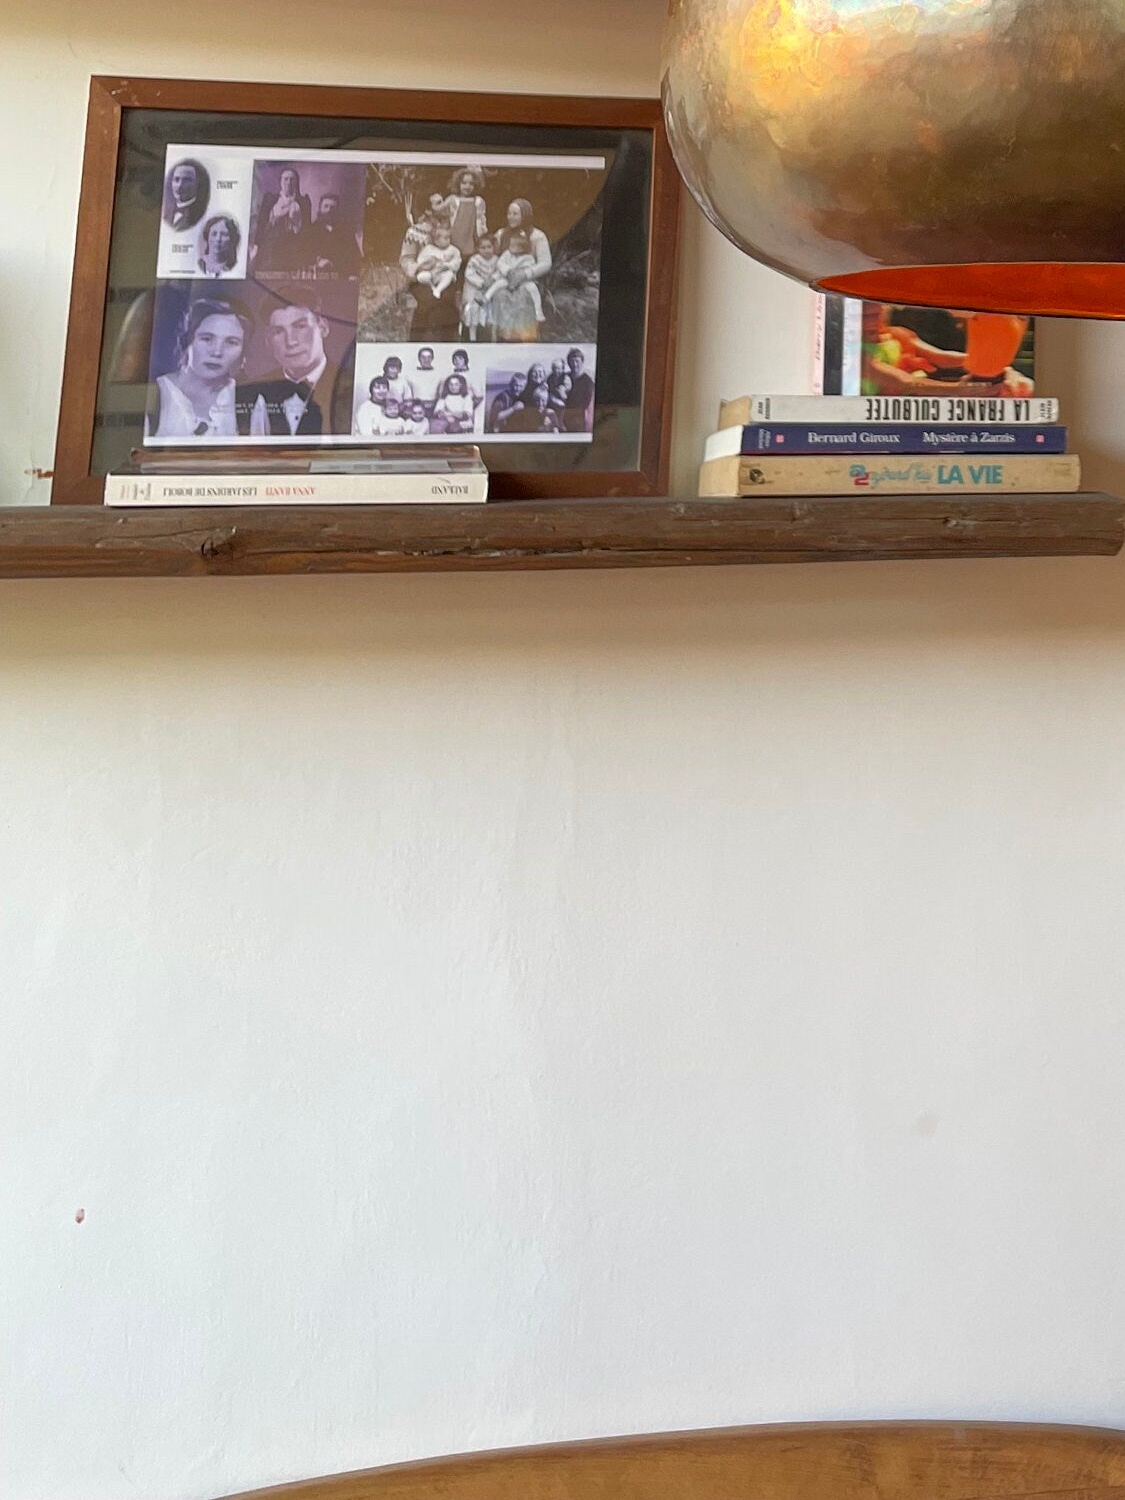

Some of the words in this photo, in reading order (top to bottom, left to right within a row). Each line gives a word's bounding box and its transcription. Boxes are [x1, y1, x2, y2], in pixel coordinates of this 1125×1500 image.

[947, 399, 1005, 421] FRANCE
[1013, 399, 1030, 421] LA
[807, 431, 857, 444] Bernard
[859, 431, 900, 444] Giroux
[921, 431, 969, 446] Mystère
[969, 431, 979, 444] à
[937, 464, 965, 485] LA
[967, 464, 1004, 485] VIE
